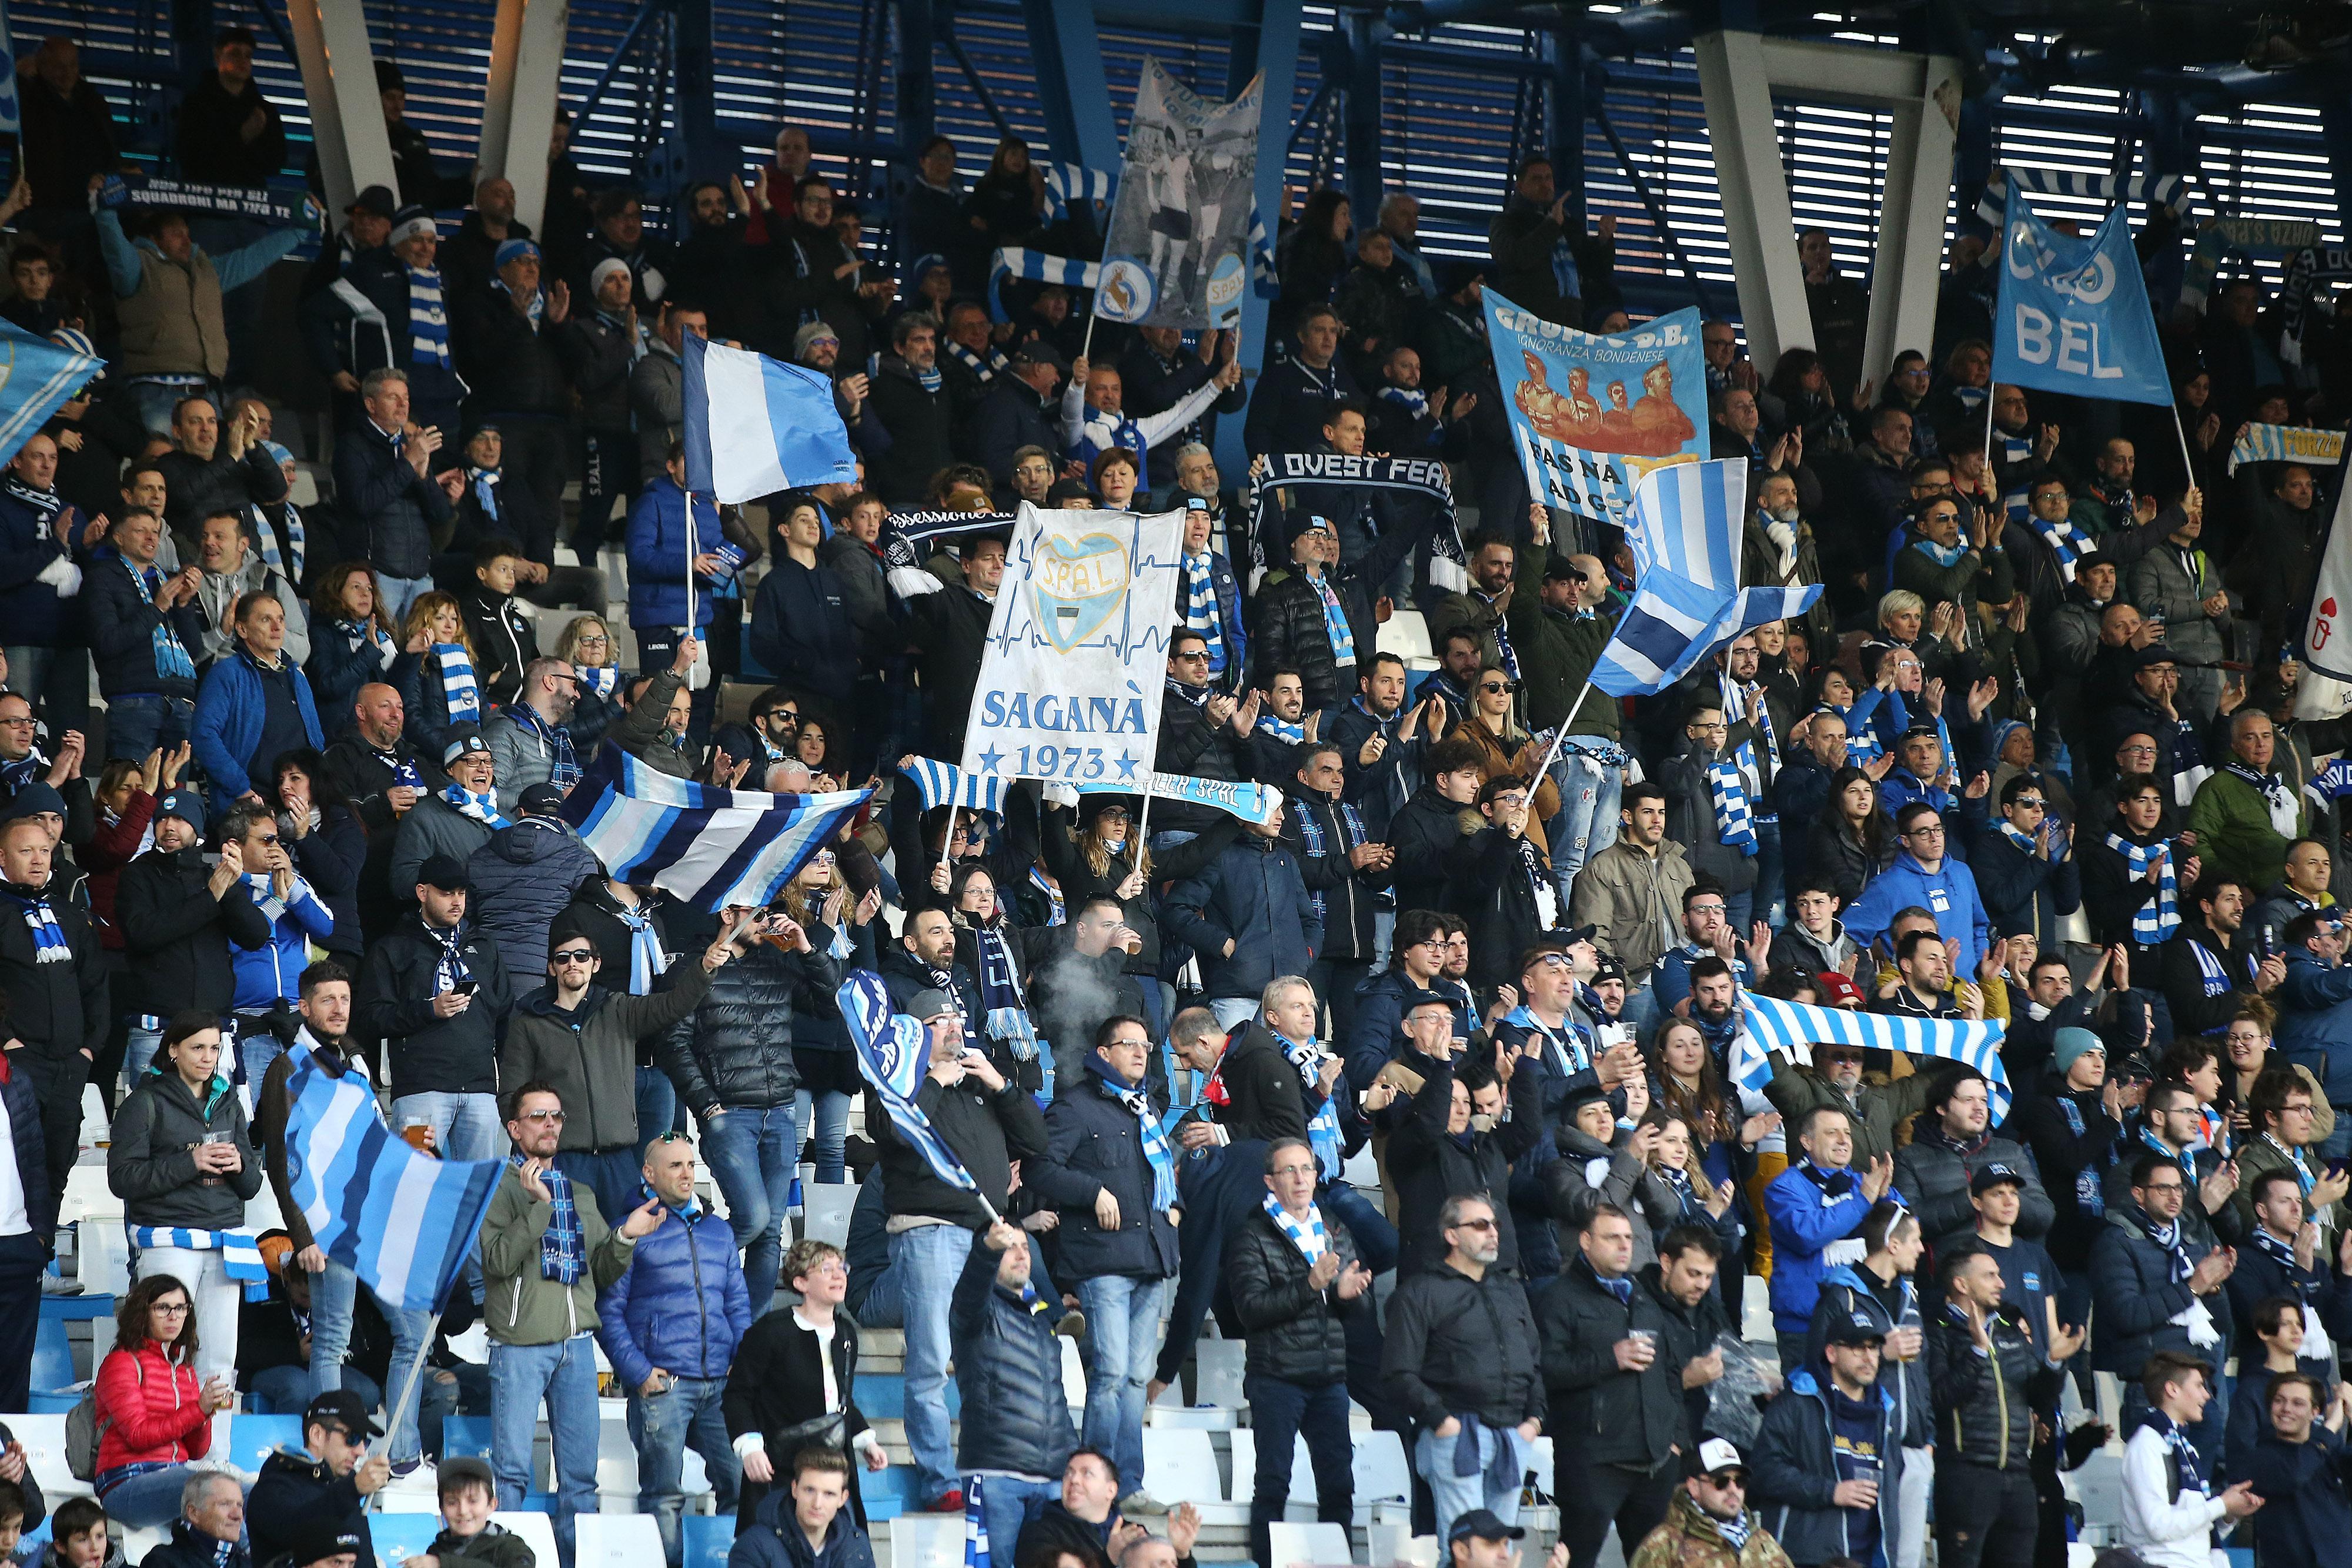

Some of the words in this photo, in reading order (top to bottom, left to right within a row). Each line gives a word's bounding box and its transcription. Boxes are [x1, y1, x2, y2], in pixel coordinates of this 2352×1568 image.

[131, 189, 212, 208] SQUADRONI
[215, 197, 238, 212] MA
[273, 205, 292, 219] TE
[1517, 333, 1589, 360] IGNORANZA
[1593, 348, 1665, 363] BONDENESE
[2016, 302, 2124, 379] BEL
[2283, 429, 2341, 459] FORZA
[1284, 453, 1379, 479] OVEST
[981, 679, 1148, 734] SAGANÀ
[1014, 744, 1105, 779] 1973
[1195, 778, 1240, 808] SPAL
